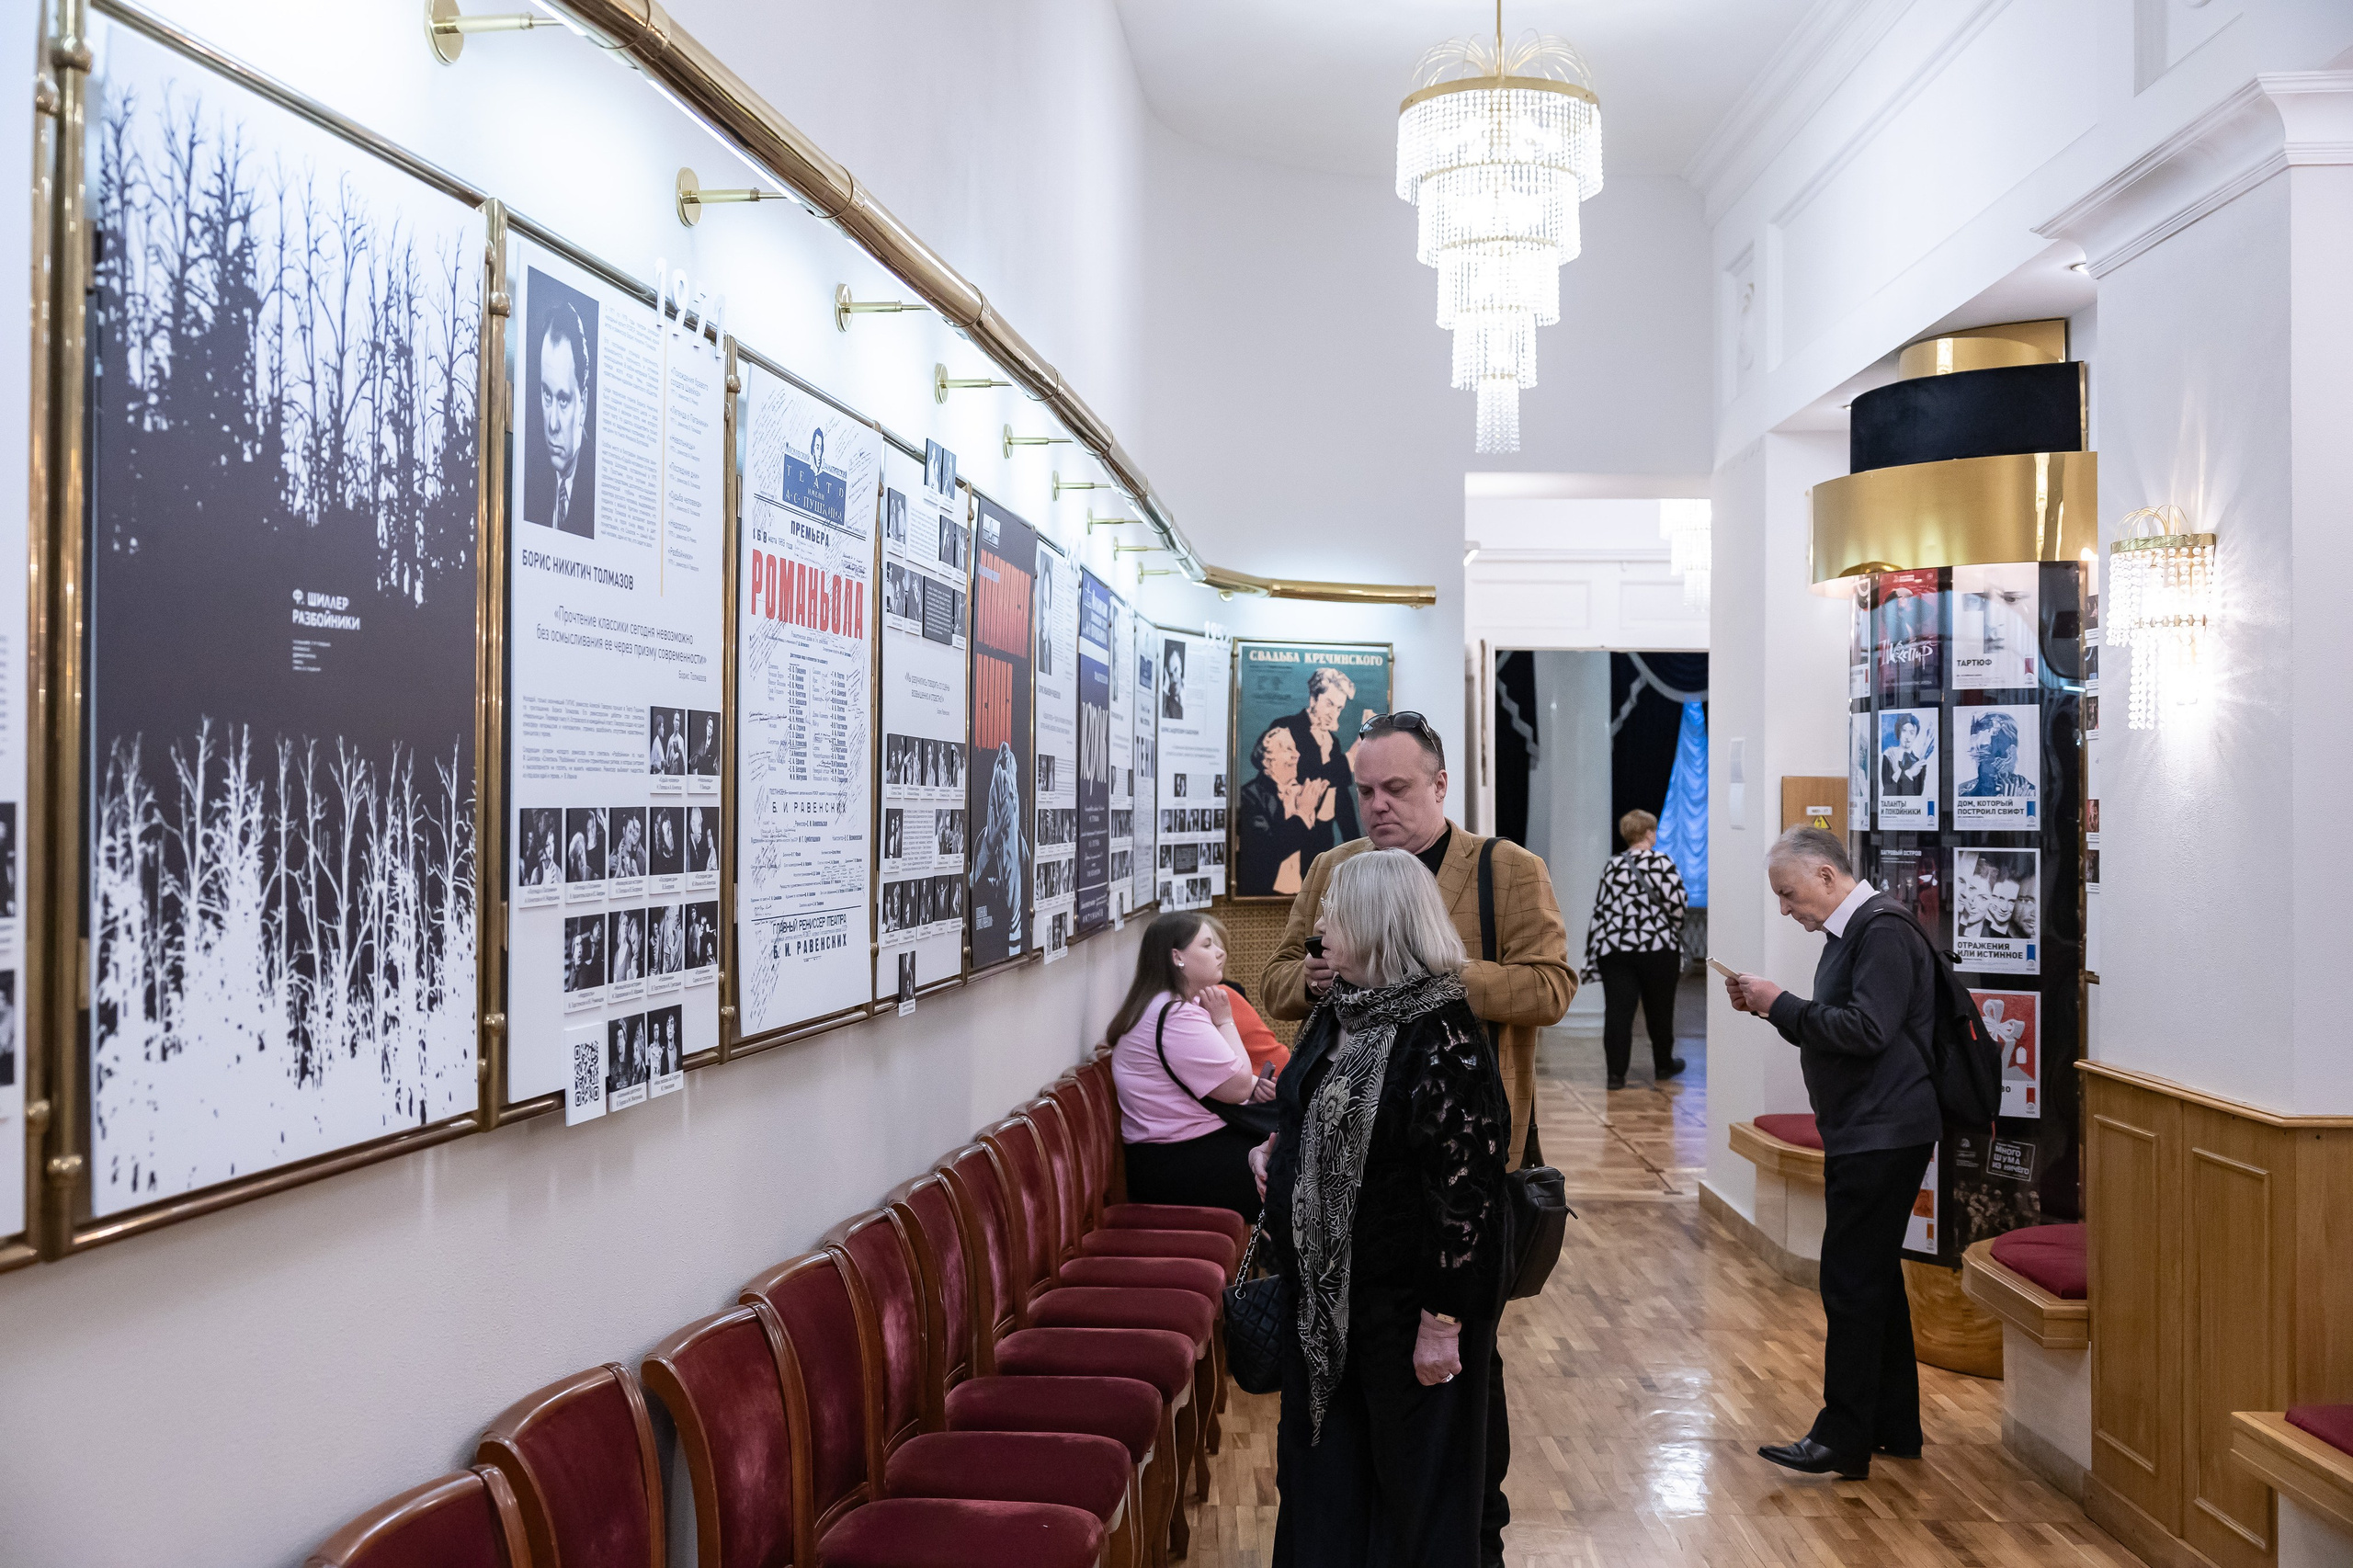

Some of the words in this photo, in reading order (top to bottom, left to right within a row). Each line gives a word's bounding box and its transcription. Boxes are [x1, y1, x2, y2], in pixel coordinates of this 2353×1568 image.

[790, 520, 830, 548] ПРЕМЬЕРА
[522, 550, 551, 572] БОРИС
[552, 556, 592, 582] НИКИТИЧ
[594, 566, 634, 590] ТОЛМАЗОВ
[308, 592, 349, 611] ШИЛЛЕР
[752, 549, 864, 640] РОМАНЬОЛА
[292, 608, 361, 631] РАЗБОЙНИКИ
[554, 605, 597, 627] «Прочтение
[598, 616, 629, 633] классики
[630, 622, 655, 639] сегодня
[656, 628, 694, 645] невозможно
[537, 623, 550, 641] без
[614, 640, 632, 656] через
[634, 643, 656, 661] призму
[657, 649, 708, 665] современности»
[1249, 650, 1301, 663] СВАДЬБА
[1304, 652, 1383, 666] КРЕЧИНСКОГО
[793, 801, 847, 814] РАВЕНСКИХ
[1977, 799, 2013, 807] КОТОРЫЙ
[1885, 808, 1921, 816] ПОКОЙНИКИ
[797, 933, 847, 956] РАВЕНСКИХ
[1958, 942, 2010, 950] ОТРАЖЕНИЯ
[1977, 950, 2023, 960] ИСТИННОЕ
[1994, 1153, 2020, 1165] ШУМА
[1995, 1145, 2021, 1157] МНОГО
[1992, 1161, 2002, 1169] ИЗ
[2004, 1164, 2029, 1176] НИЧЕГО
